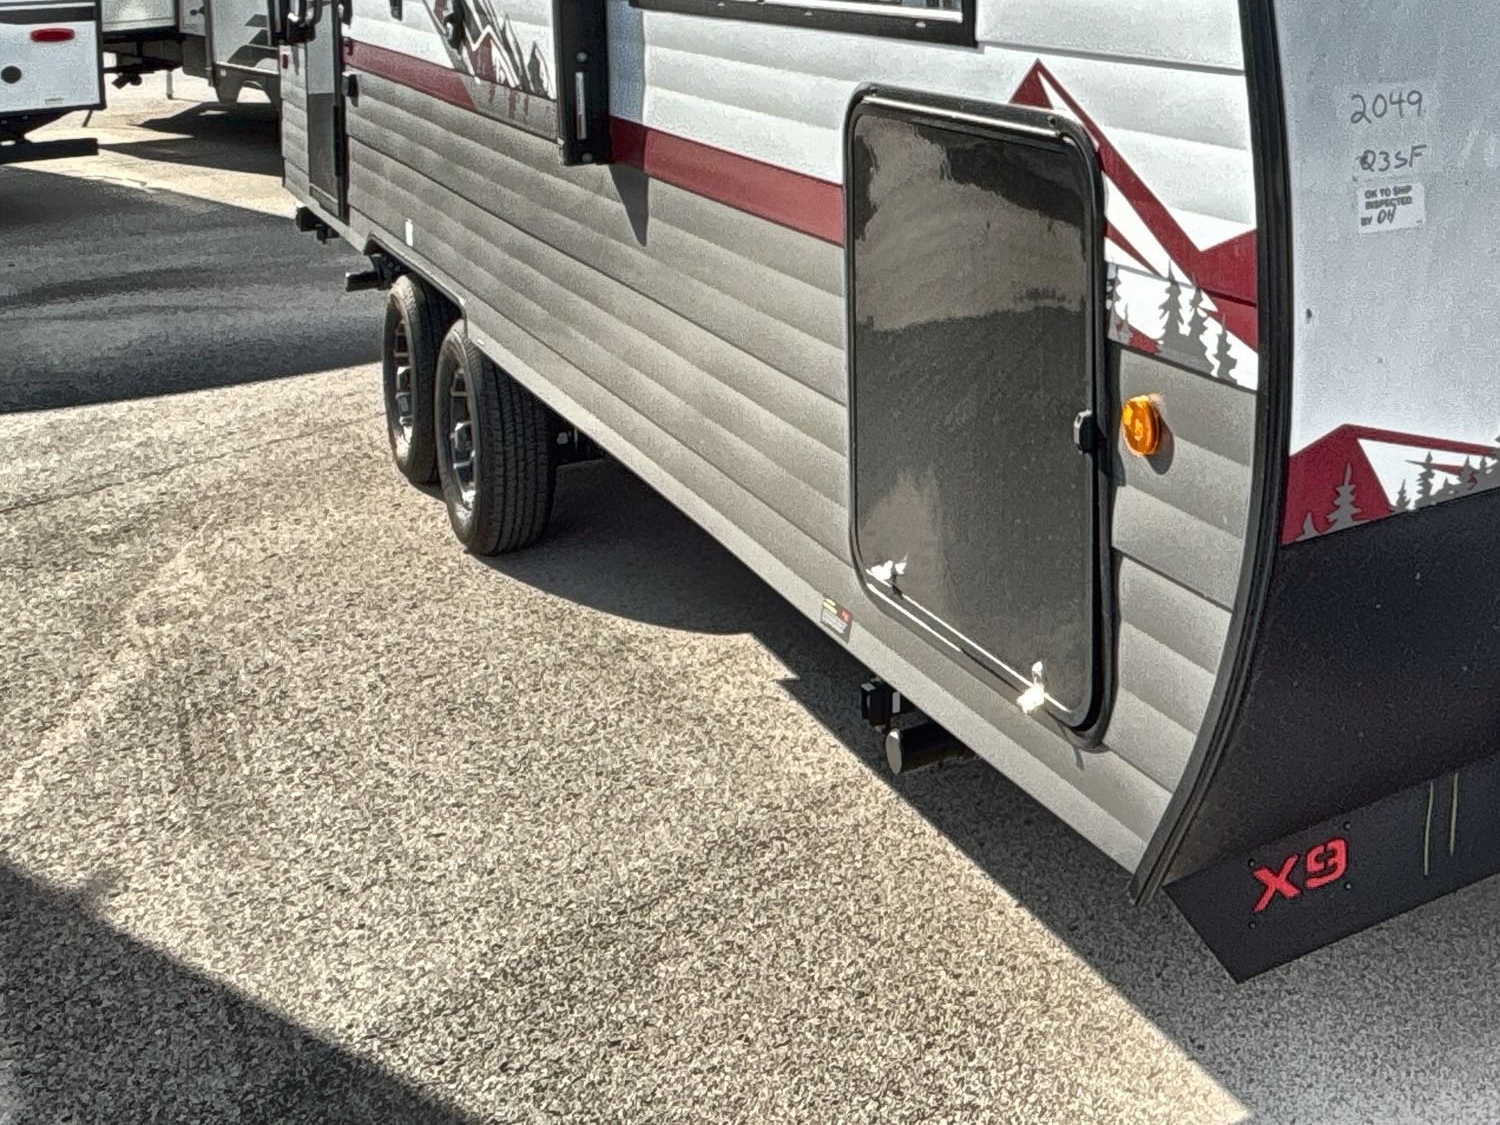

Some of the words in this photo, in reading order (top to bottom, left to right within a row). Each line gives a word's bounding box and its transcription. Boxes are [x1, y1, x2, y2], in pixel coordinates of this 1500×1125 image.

[1350, 89, 1423, 125] 2049
[1364, 189, 1378, 200] OK
[1379, 187, 1392, 198] TO
[1365, 196, 1413, 210] INSPECTED
[1252, 837, 1349, 913] X9
